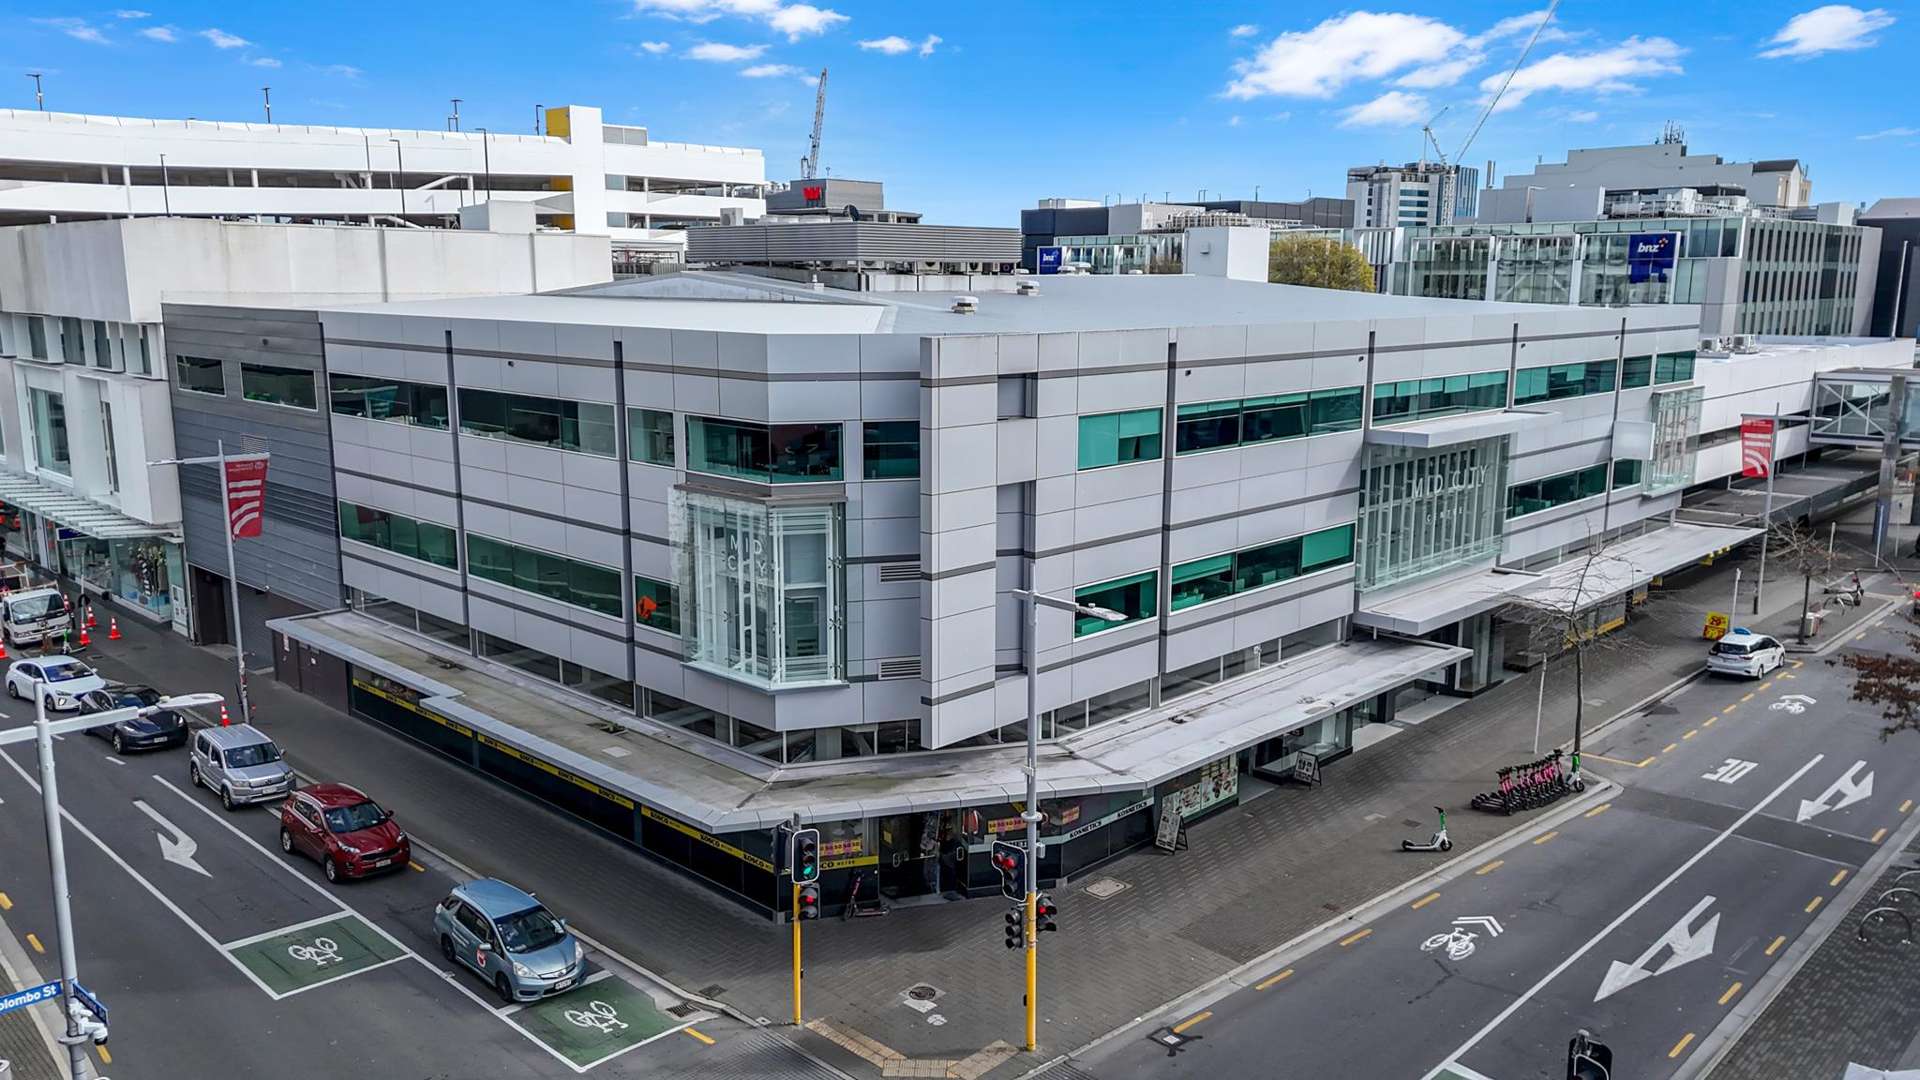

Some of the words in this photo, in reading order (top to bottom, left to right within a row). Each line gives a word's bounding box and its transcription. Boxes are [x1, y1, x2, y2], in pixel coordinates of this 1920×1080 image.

[1637, 242, 1659, 253] bnz
[1411, 475, 1444, 499] MID
[1452, 464, 1488, 489] CITY
[730, 534, 762, 554] MID
[727, 555, 767, 577] CY
[1701, 758, 1760, 784] 30
[43, 984, 57, 997] St
